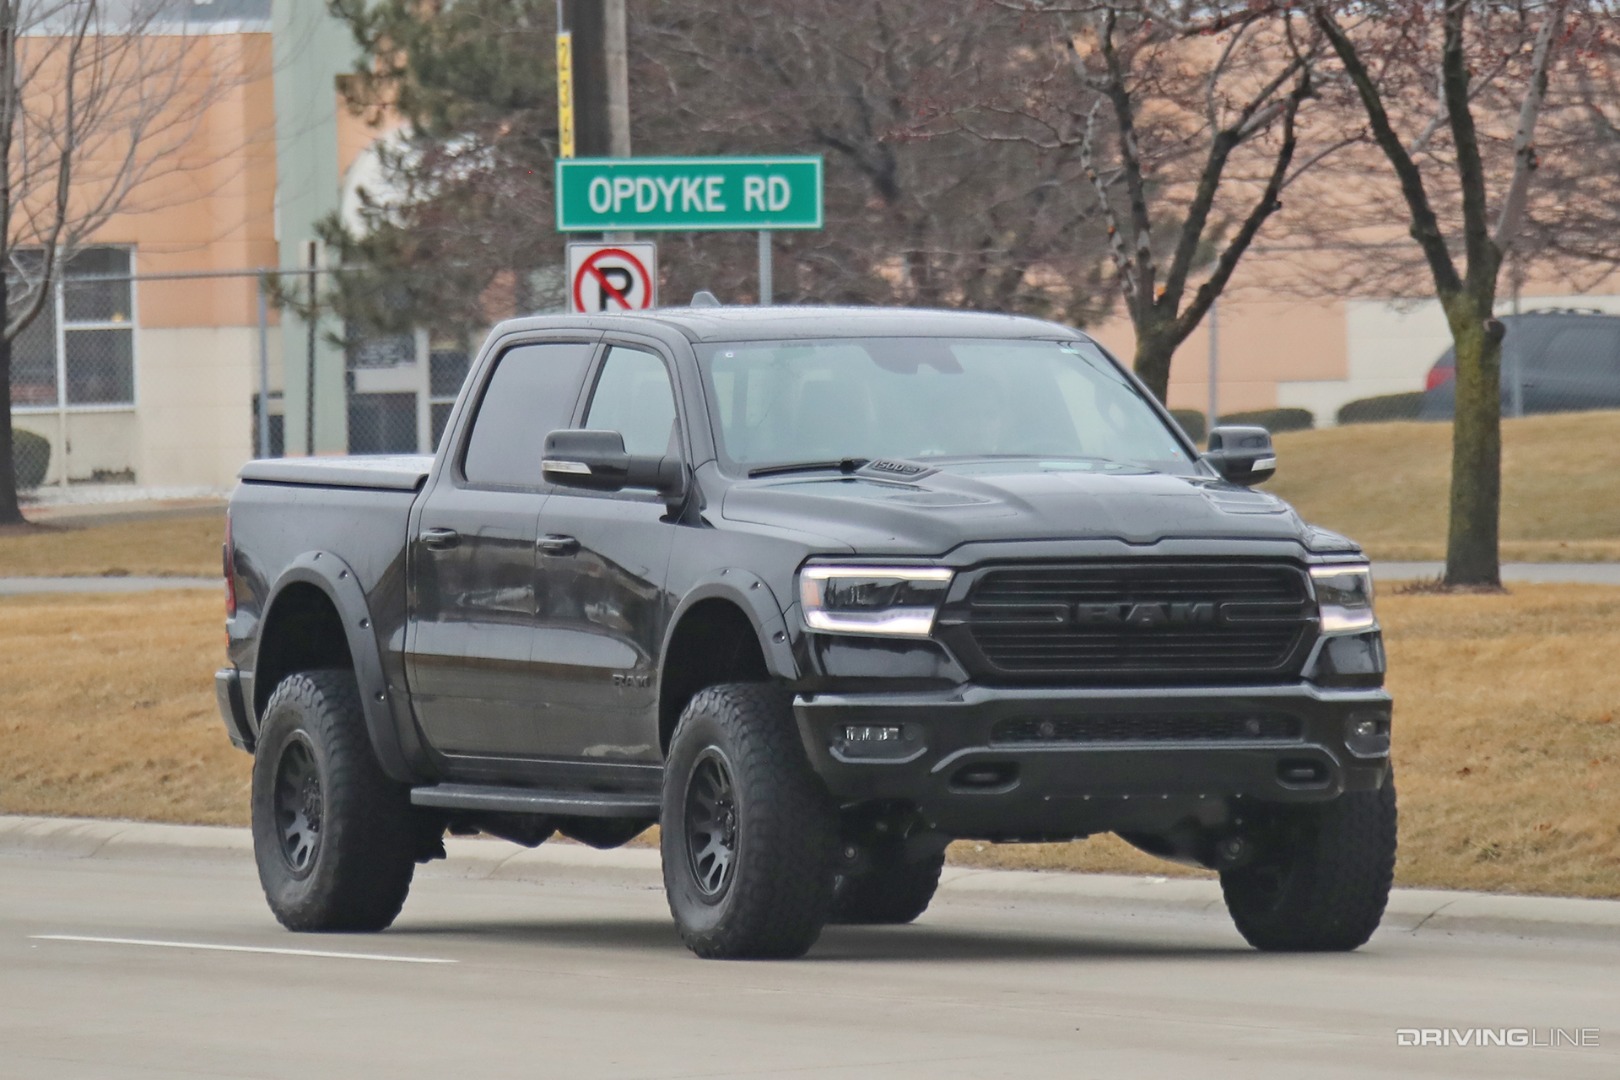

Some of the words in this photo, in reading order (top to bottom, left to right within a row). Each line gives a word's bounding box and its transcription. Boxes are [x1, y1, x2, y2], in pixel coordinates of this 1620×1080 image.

[588, 176, 726, 214] OPDYKE
[744, 176, 791, 212] RD
[874, 460, 905, 472] 1500
[1077, 602, 1215, 623] RAM
[612, 673, 651, 688] RAM
